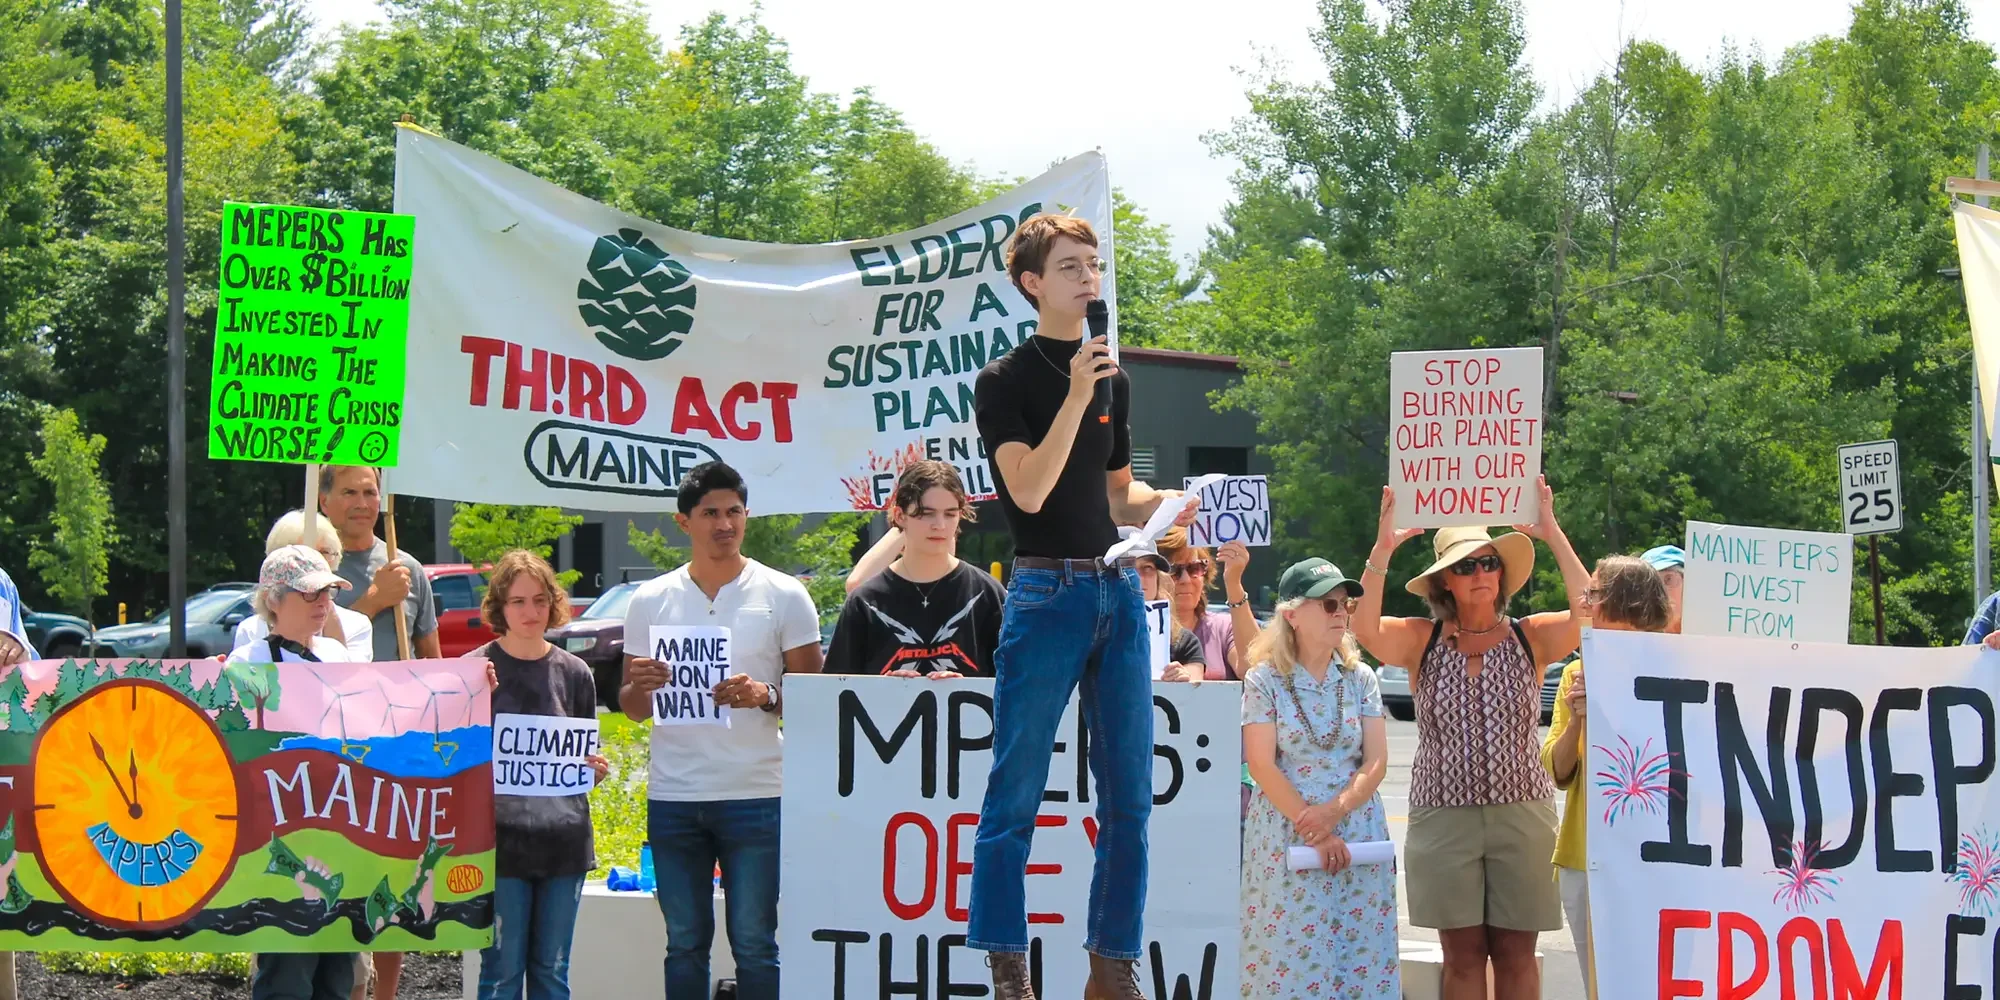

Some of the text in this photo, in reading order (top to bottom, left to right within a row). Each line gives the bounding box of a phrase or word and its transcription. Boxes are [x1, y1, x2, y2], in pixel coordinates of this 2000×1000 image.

[231, 207, 344, 253] MEPERS
[224, 253, 291, 291] OVER
[223, 297, 338, 338] INVESTED
[873, 283, 1009, 336] FOR A
[218, 342, 318, 382] MAKING
[1424, 358, 1500, 386] STOP
[217, 380, 400, 427] CLIMATE CRISIS
[461, 336, 798, 443] TH!RD ACT
[1404, 388, 1524, 418] BURNING
[214, 422, 346, 462] WORSE!
[1396, 419, 1537, 451] OUR PLANET
[1400, 452, 1526, 482] WITH OUR
[1844, 452, 1892, 470] SPEED
[1186, 479, 1267, 512] IVEST
[1850, 470, 1888, 488] LIMIT
[1415, 486, 1521, 515] MONEY!
[1848, 489, 1894, 525] 25
[1189, 511, 1268, 545] NOW
[1691, 532, 1839, 573] MAINE PERS
[1723, 572, 1806, 604] DIVEST
[1728, 606, 1794, 639] FROM
[655, 637, 728, 661] MAINE
[499, 727, 598, 757] CLIMATE
[496, 760, 588, 787] JUSTICE
[264, 761, 456, 841] MAINE
[90, 824, 199, 887] MPERS
